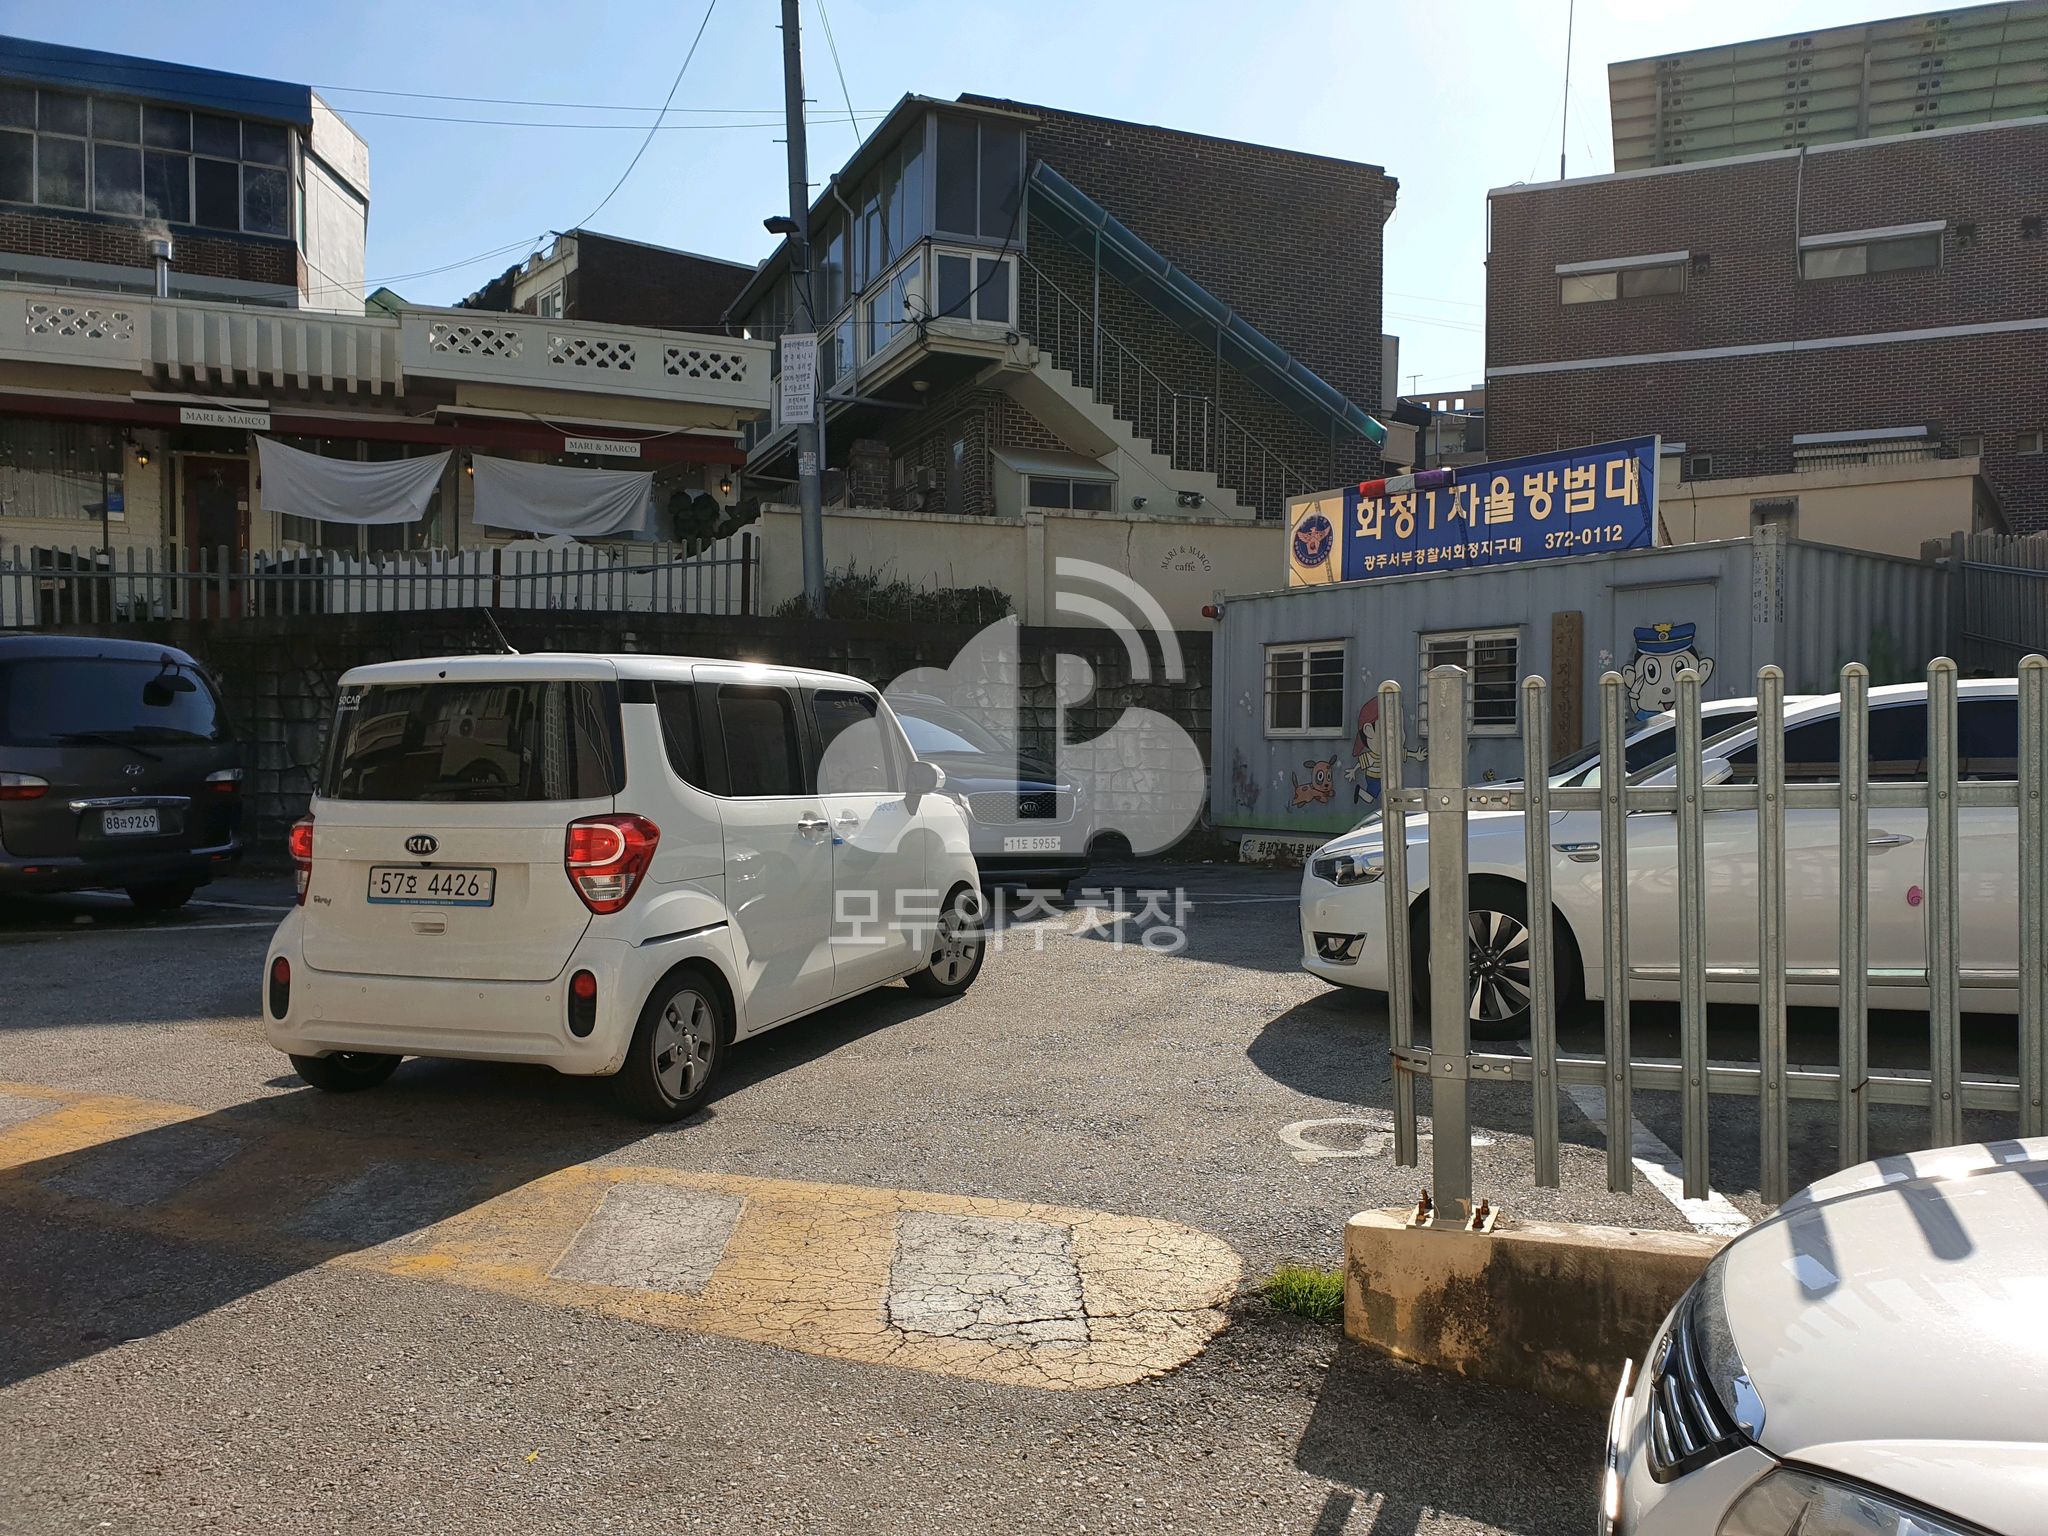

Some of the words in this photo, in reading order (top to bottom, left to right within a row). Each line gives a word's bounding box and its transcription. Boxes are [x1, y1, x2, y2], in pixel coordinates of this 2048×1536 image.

[186, 412, 214, 421] MARI
[228, 415, 266, 426] MARCO
[569, 441, 593, 450] MARI
[604, 444, 637, 453] MARCO
[1544, 524, 1623, 549] 372-0112
[408, 838, 433, 851] KIA
[1032, 838, 1057, 849] 5955
[380, 872, 417, 895] 57호
[427, 873, 480, 896] 4426
